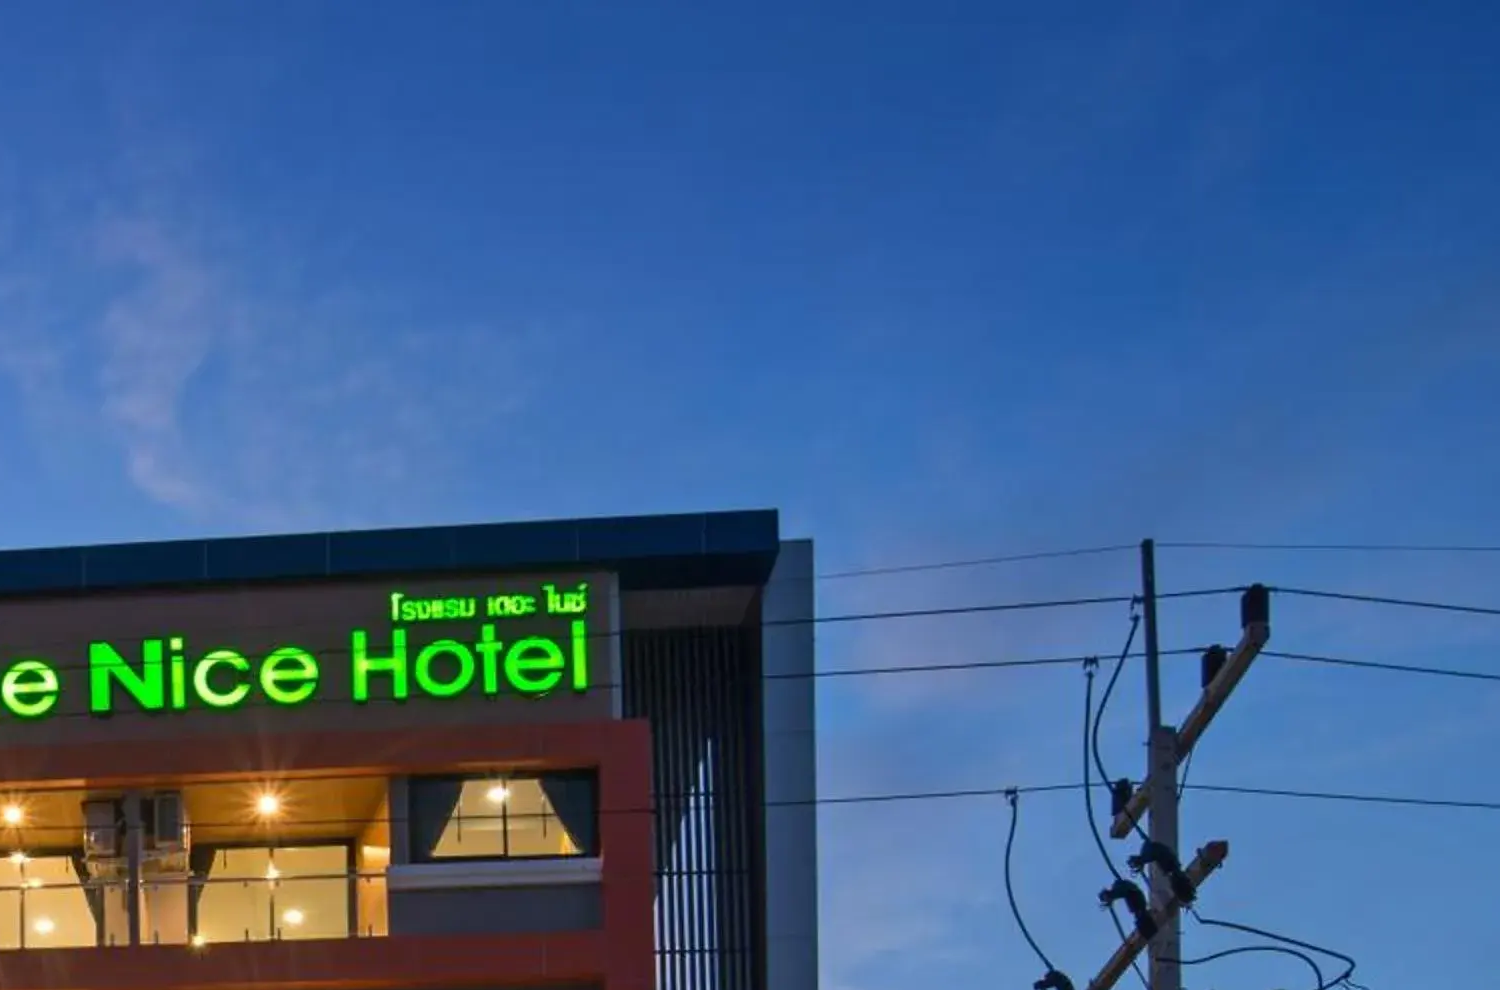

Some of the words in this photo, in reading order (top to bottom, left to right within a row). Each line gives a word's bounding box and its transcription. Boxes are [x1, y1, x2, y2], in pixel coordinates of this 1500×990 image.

[391, 591, 476, 621] โรงแรม
[89, 637, 319, 712] Nice
[351, 619, 588, 701] Hotel
